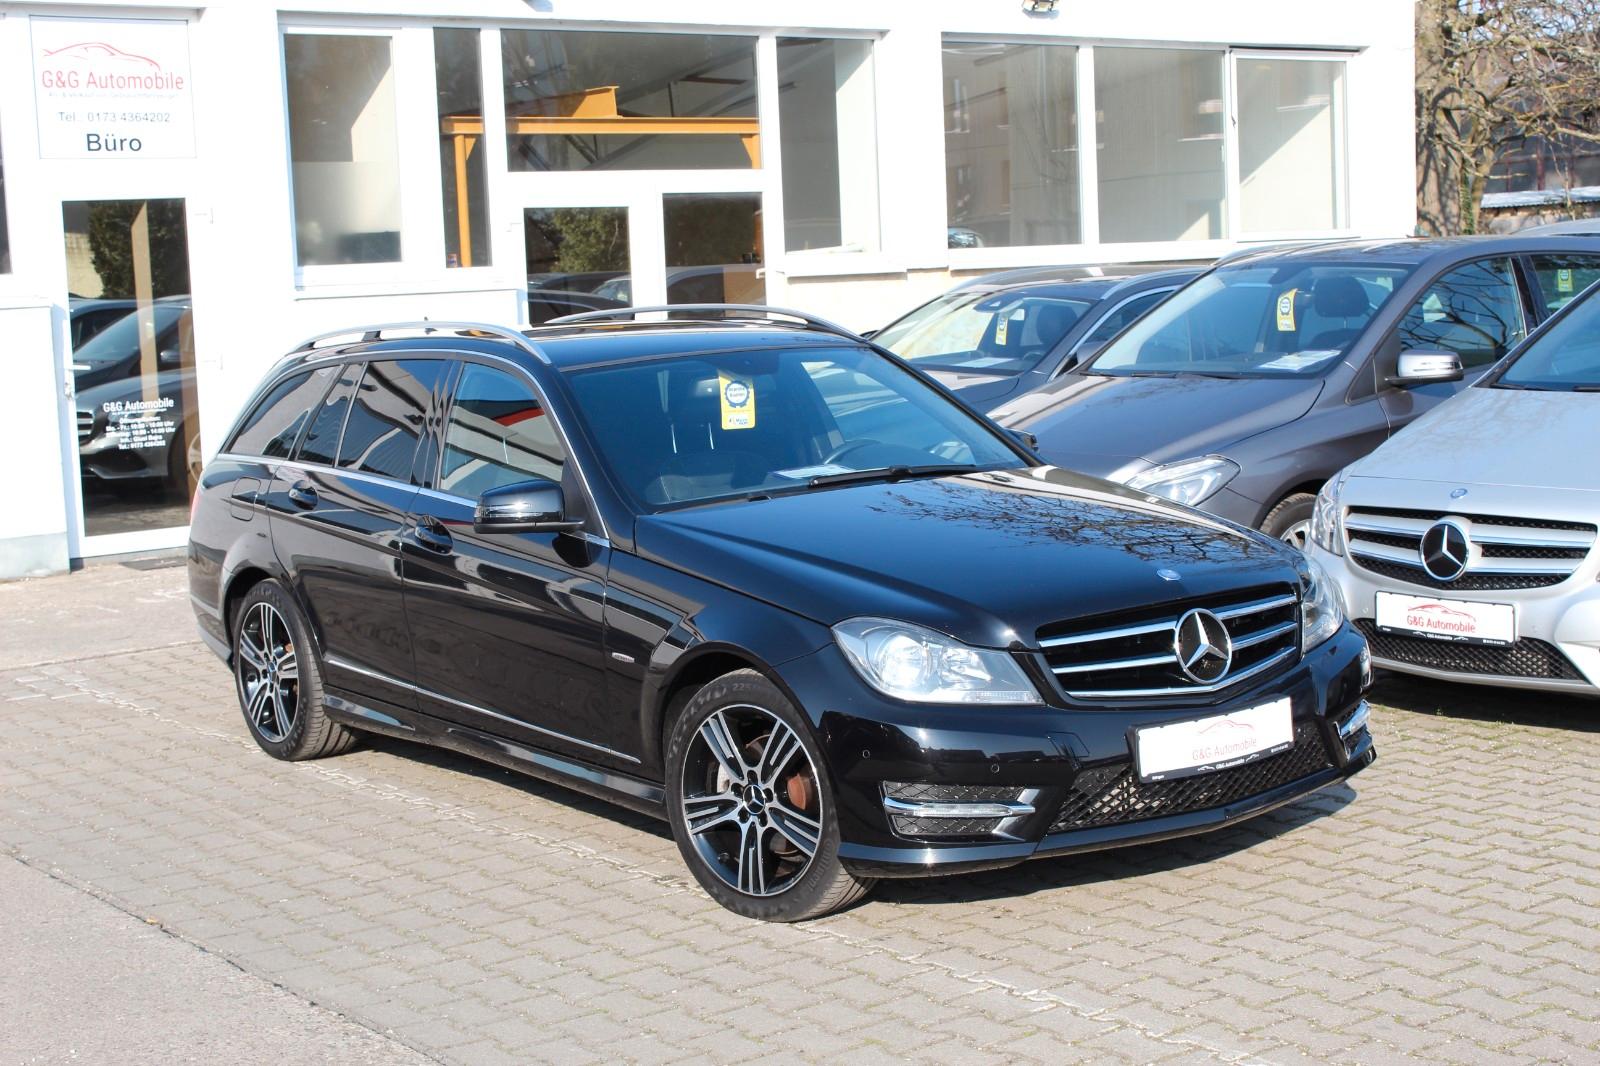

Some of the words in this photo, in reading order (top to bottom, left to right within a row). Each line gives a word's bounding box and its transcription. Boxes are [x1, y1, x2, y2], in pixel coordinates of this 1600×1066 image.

[42, 70, 79, 89] G&G
[86, 71, 184, 90] Automobile
[87, 111, 117, 123] 0173
[120, 111, 171, 123] 4364202
[86, 133, 143, 152] Büro
[103, 402, 122, 412] G&G
[125, 398, 174, 410] Automobile
[1407, 615, 1425, 628] G&G
[1427, 619, 1476, 633] Automobile
[1192, 748, 1212, 761] G&G
[1214, 738, 1257, 756] Automobile
